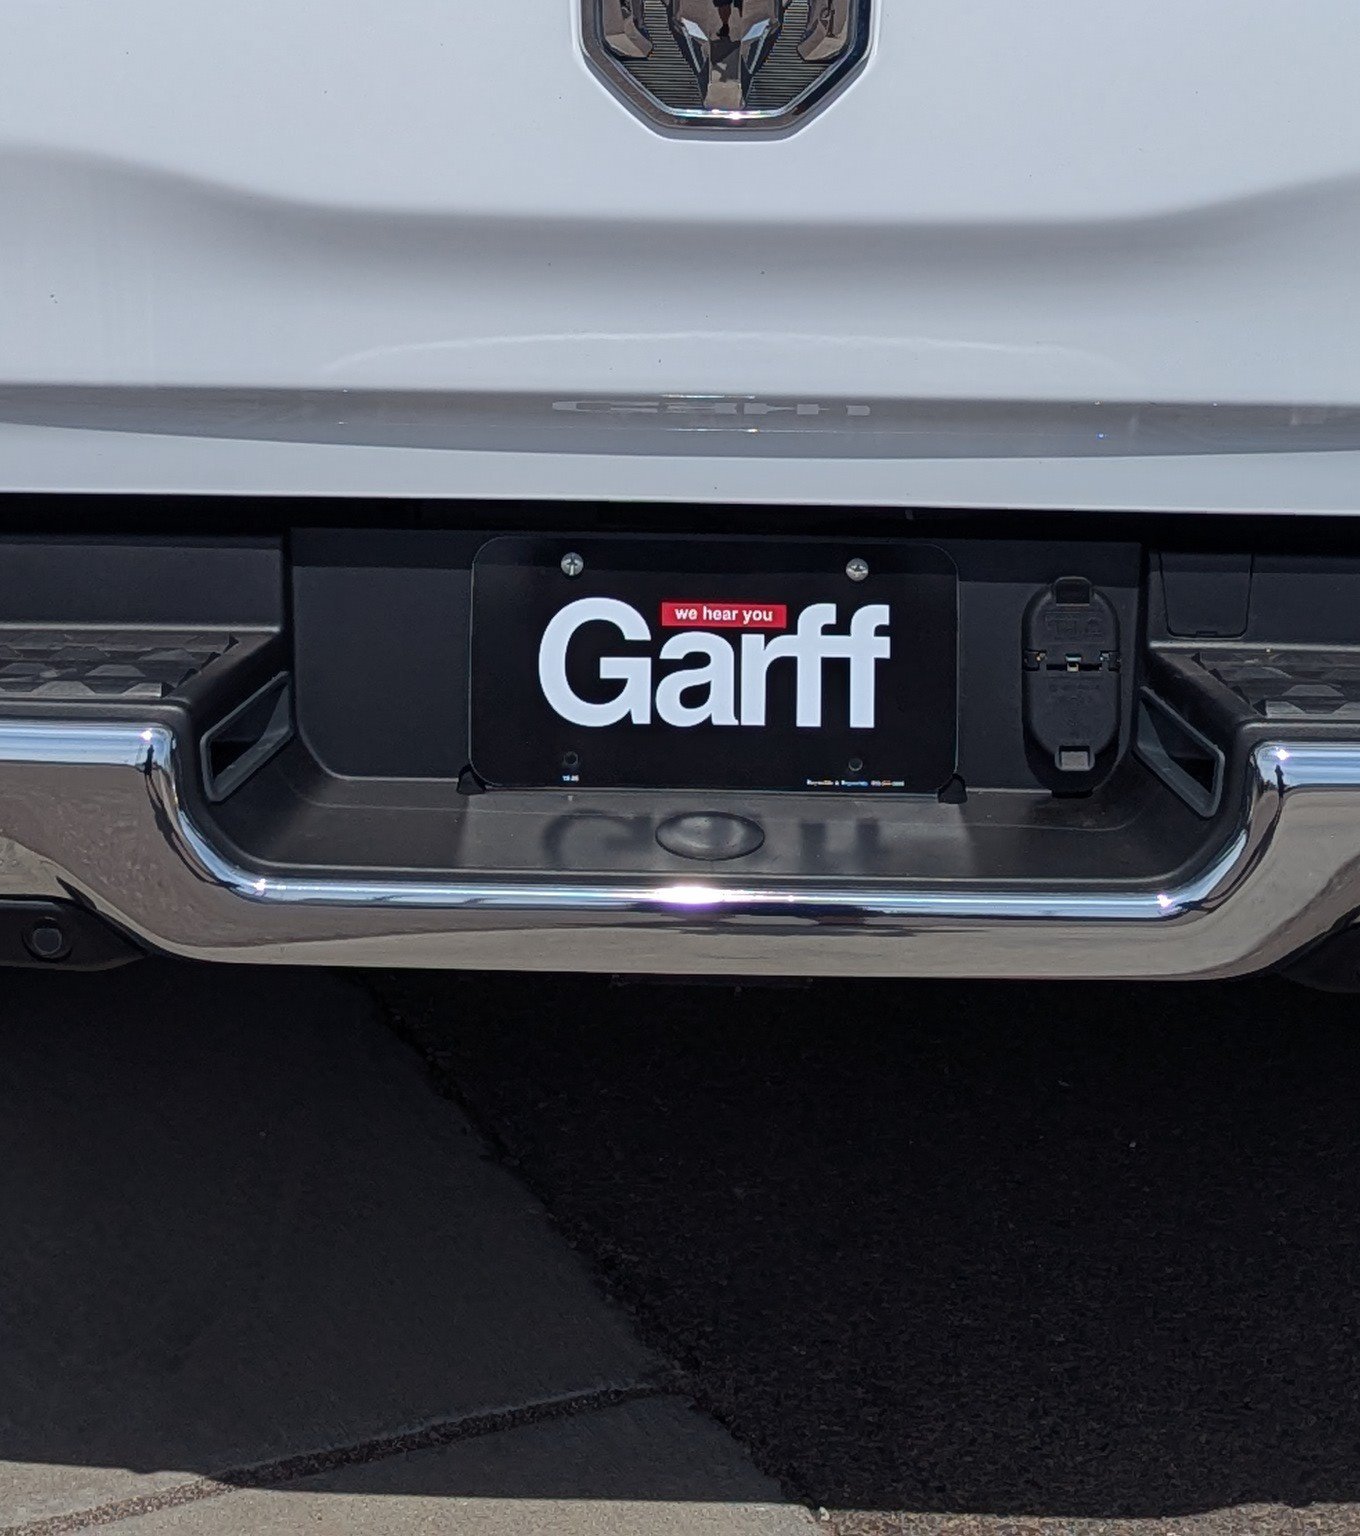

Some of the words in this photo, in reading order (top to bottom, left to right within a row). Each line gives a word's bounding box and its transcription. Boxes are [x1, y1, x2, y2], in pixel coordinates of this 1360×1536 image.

[674, 608, 698, 620] we
[702, 605, 739, 621] hear
[742, 609, 773, 625] you
[538, 597, 892, 728] Garff
